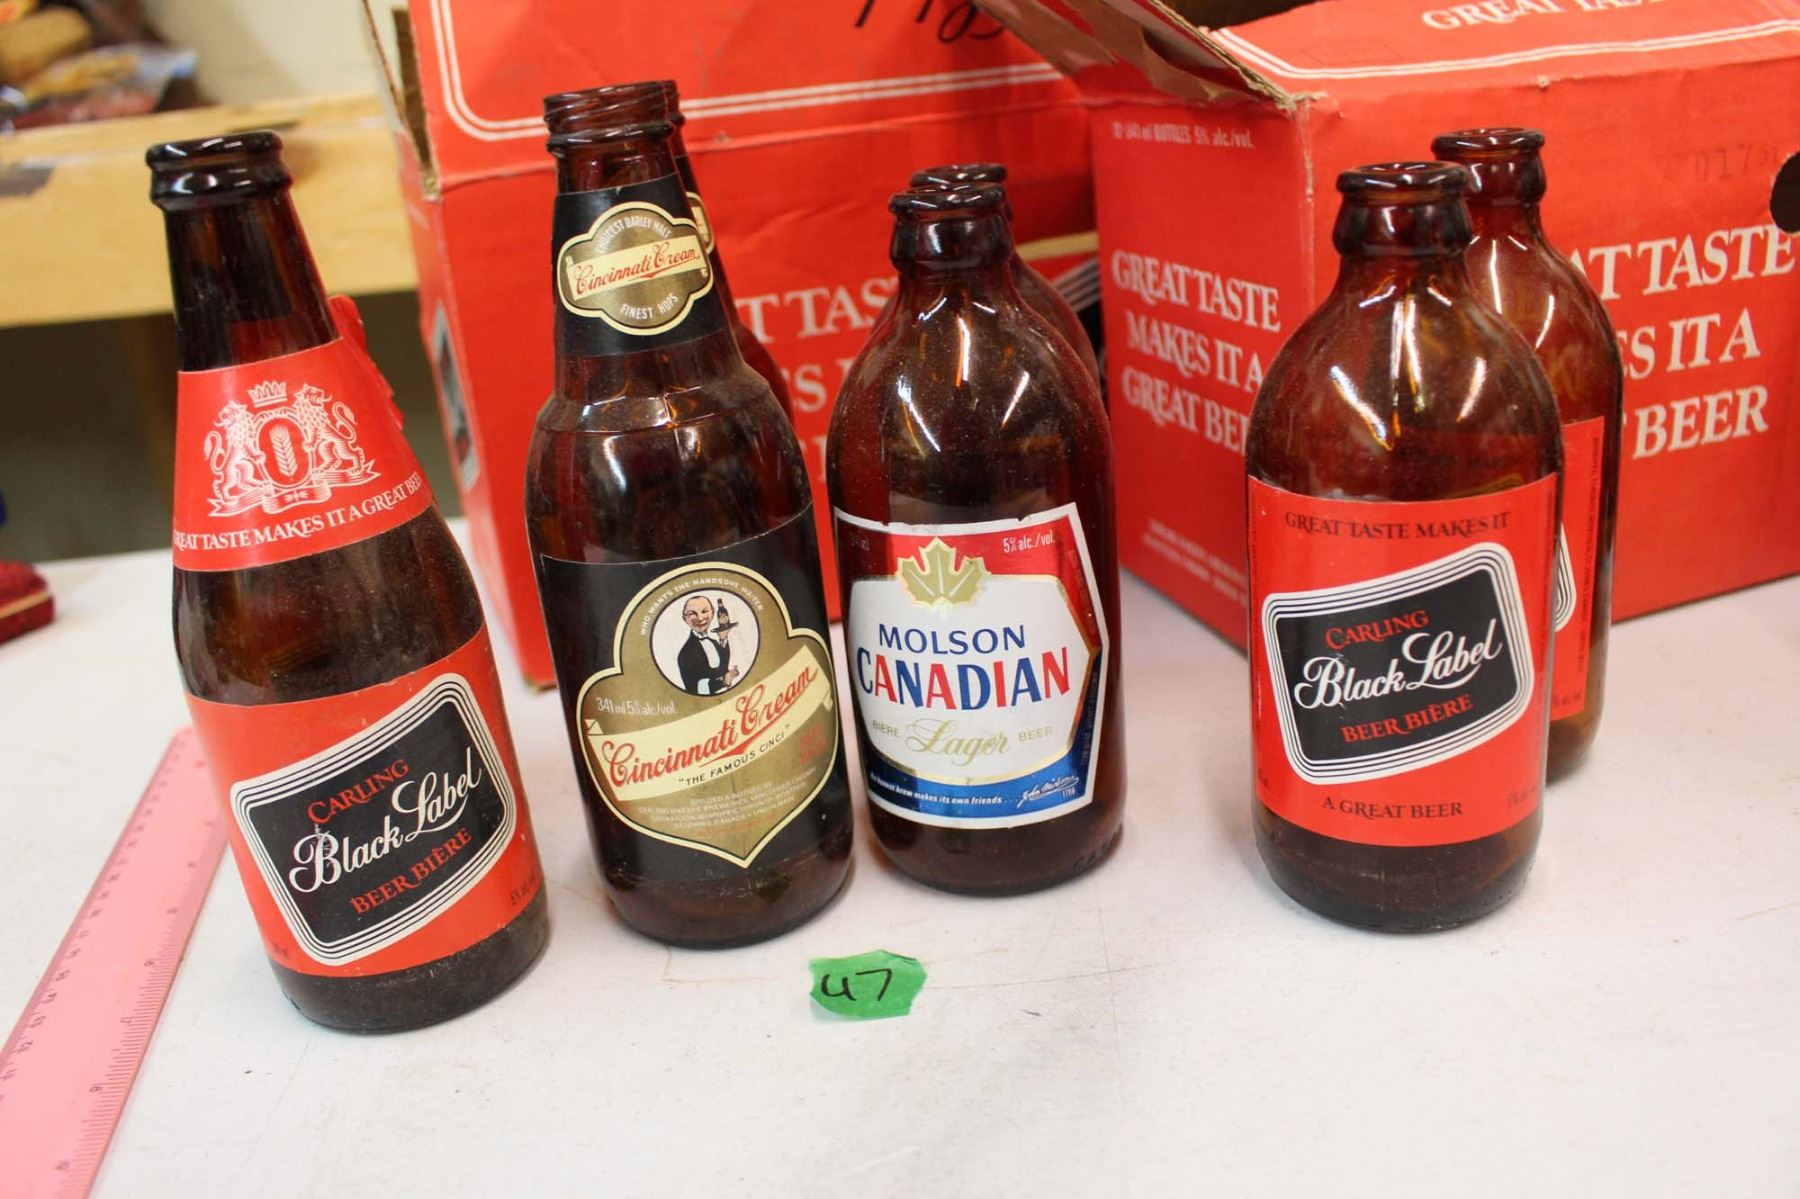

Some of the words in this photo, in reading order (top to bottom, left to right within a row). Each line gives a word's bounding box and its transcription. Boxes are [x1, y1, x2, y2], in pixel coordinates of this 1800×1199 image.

[574, 253, 652, 296] Cincinnati
[652, 241, 702, 270] Cream
[1636, 223, 1797, 297] TASTE
[619, 302, 654, 320] FINEST
[658, 292, 679, 316] HOPS
[1111, 249, 1190, 307] GREAT
[1192, 268, 1282, 334] TASTE
[1125, 309, 1211, 379] MAKES
[1214, 338, 1244, 389] IT
[1243, 351, 1264, 394] A
[1666, 312, 1722, 373] IT
[1718, 307, 1762, 364] A
[1121, 365, 1202, 428] GREAT
[1632, 383, 1770, 461] BEER
[200, 530, 251, 551] TASTE
[253, 515, 325, 546] MAKES
[325, 507, 348, 528] IT
[348, 505, 363, 522] A
[361, 483, 408, 516] GREAT
[1002, 536, 1018, 553] 5%
[1018, 529, 1057, 551] alc./vol.
[1285, 510, 1342, 537] GREAT
[1349, 521, 1411, 540] TASTE
[1415, 517, 1489, 540] MAKES
[1490, 511, 1512, 530] IT
[640, 612, 651, 637] WHO
[648, 589, 674, 615] WANTS
[673, 580, 691, 593] THE
[692, 576, 740, 589] HANDSOME
[1325, 609, 1431, 652] CARLING
[878, 623, 1026, 656] MOLSON
[1293, 656, 1407, 709] Black
[1402, 617, 1504, 691] Label
[595, 696, 614, 713] 341
[614, 702, 626, 714] ml
[856, 645, 1071, 712] CANADIAN
[601, 718, 740, 788] Cincinnati
[734, 665, 819, 737] Cream
[904, 716, 1011, 768] Lager
[1018, 725, 1053, 743] BEER
[1339, 717, 1409, 744] BEER
[1404, 693, 1475, 731] BIÈRE
[306, 758, 411, 825] CARLING
[710, 750, 757, 779] FAMOUS
[287, 813, 404, 894] Black
[390, 746, 483, 843] Label
[913, 791, 941, 803] makes
[940, 794, 951, 804] its
[951, 796, 970, 805] own
[1320, 795, 1336, 810] A
[1339, 799, 1404, 821] GREAT
[1411, 801, 1464, 819] BEER
[350, 873, 422, 915] BEER
[410, 827, 473, 882] BIÈRE
